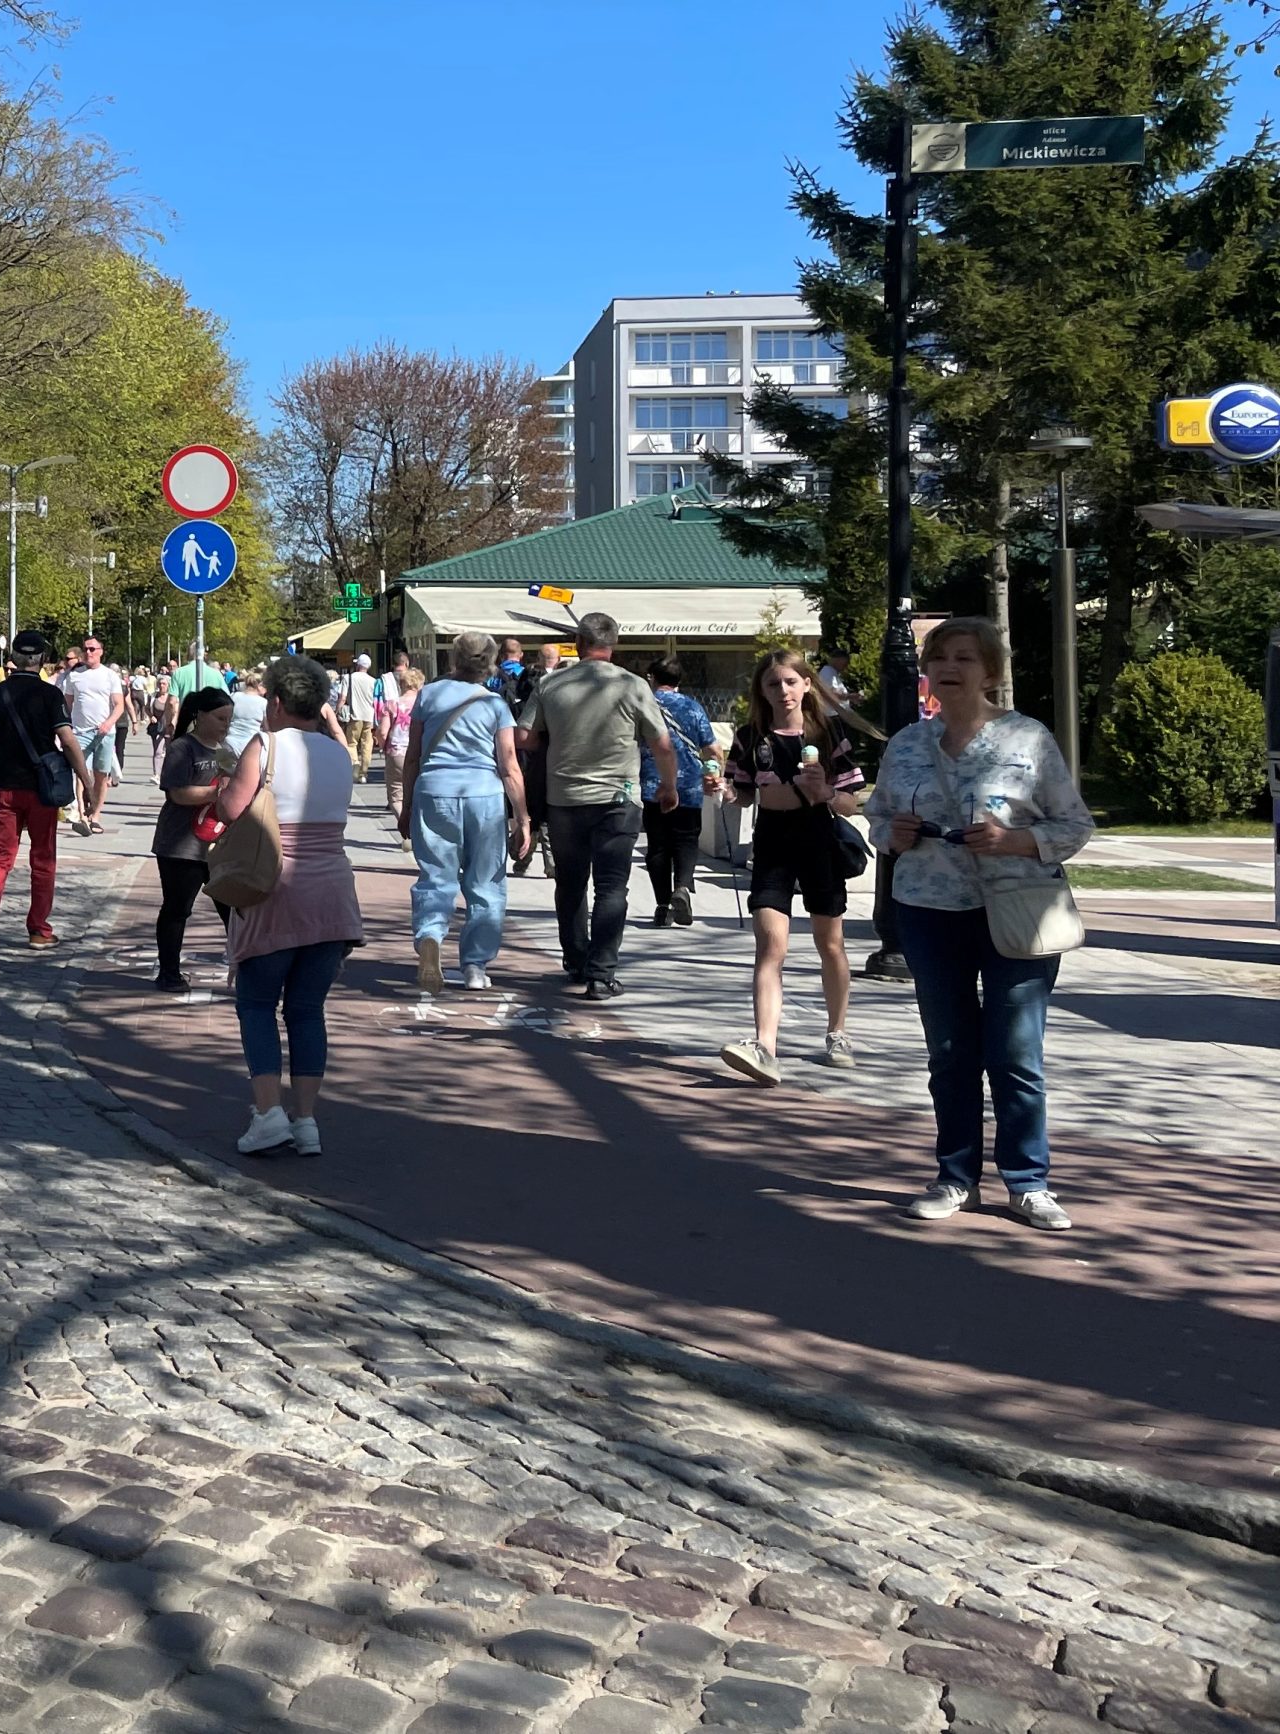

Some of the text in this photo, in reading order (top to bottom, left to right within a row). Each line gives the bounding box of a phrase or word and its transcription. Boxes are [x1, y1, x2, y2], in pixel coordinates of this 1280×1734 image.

[1002, 145, 1107, 160] Mickiewicza
[1231, 410, 1269, 419] Euronet
[641, 623, 701, 635] Magnum
[708, 622, 738, 633] Café
